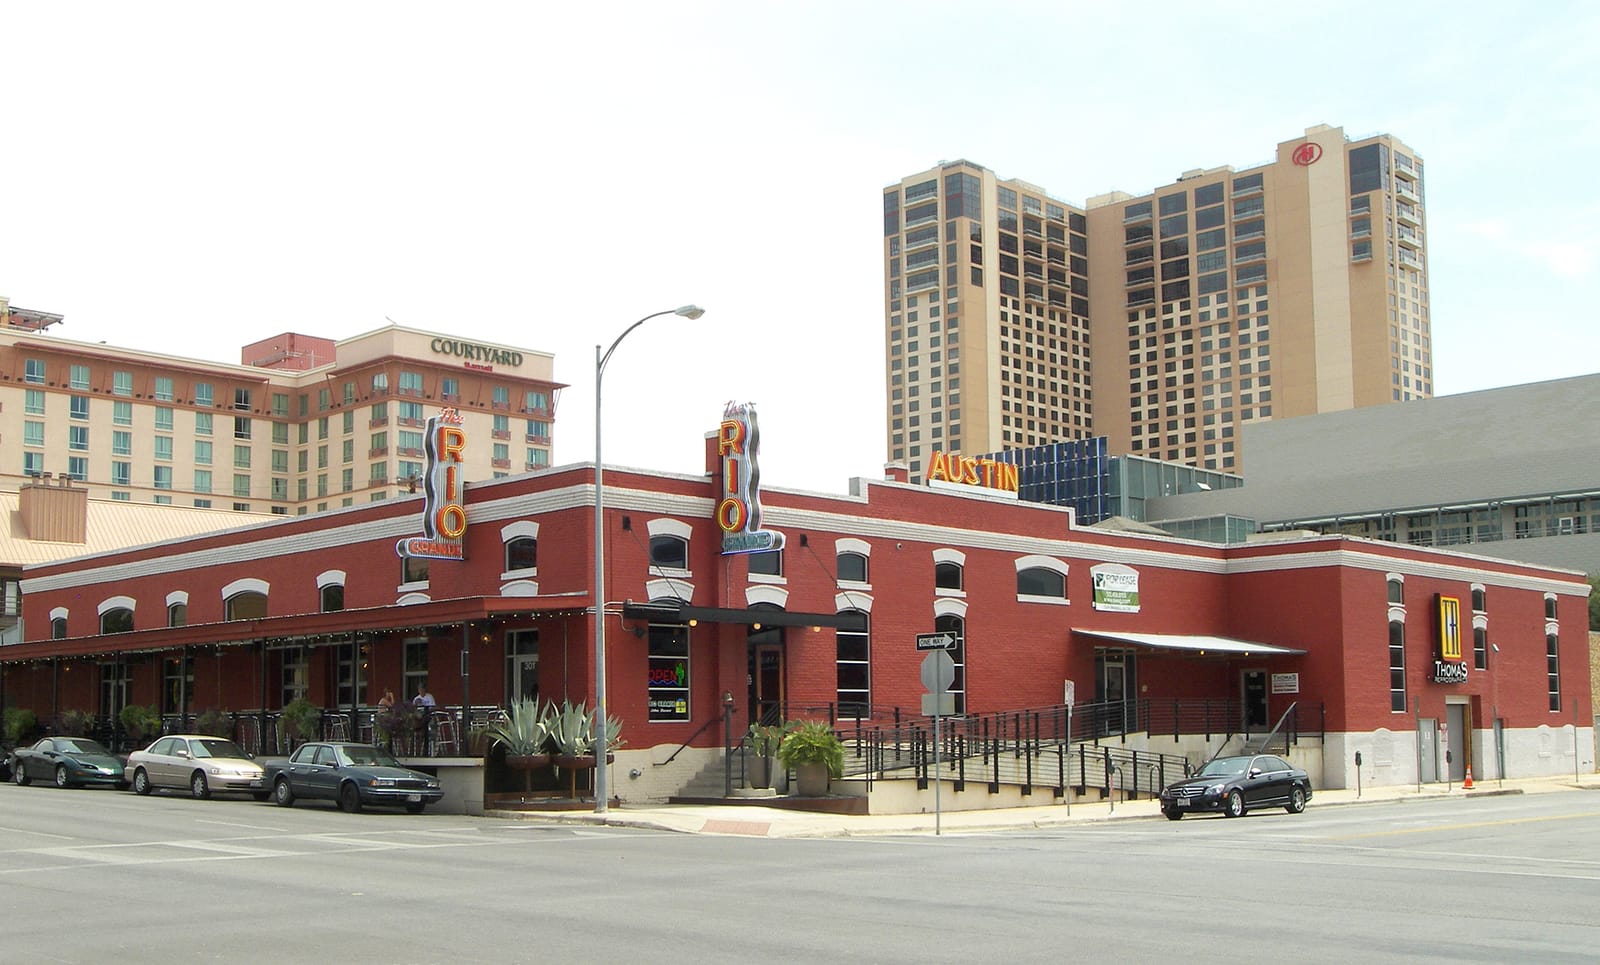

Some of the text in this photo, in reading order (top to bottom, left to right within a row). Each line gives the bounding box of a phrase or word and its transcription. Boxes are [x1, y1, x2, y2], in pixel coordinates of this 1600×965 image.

[431, 337, 523, 367] COURTYARD
[437, 426, 467, 538] RIO
[719, 419, 747, 533] RIO
[926, 450, 1018, 492] AUSTIN
[920, 638, 931, 646] ONE
